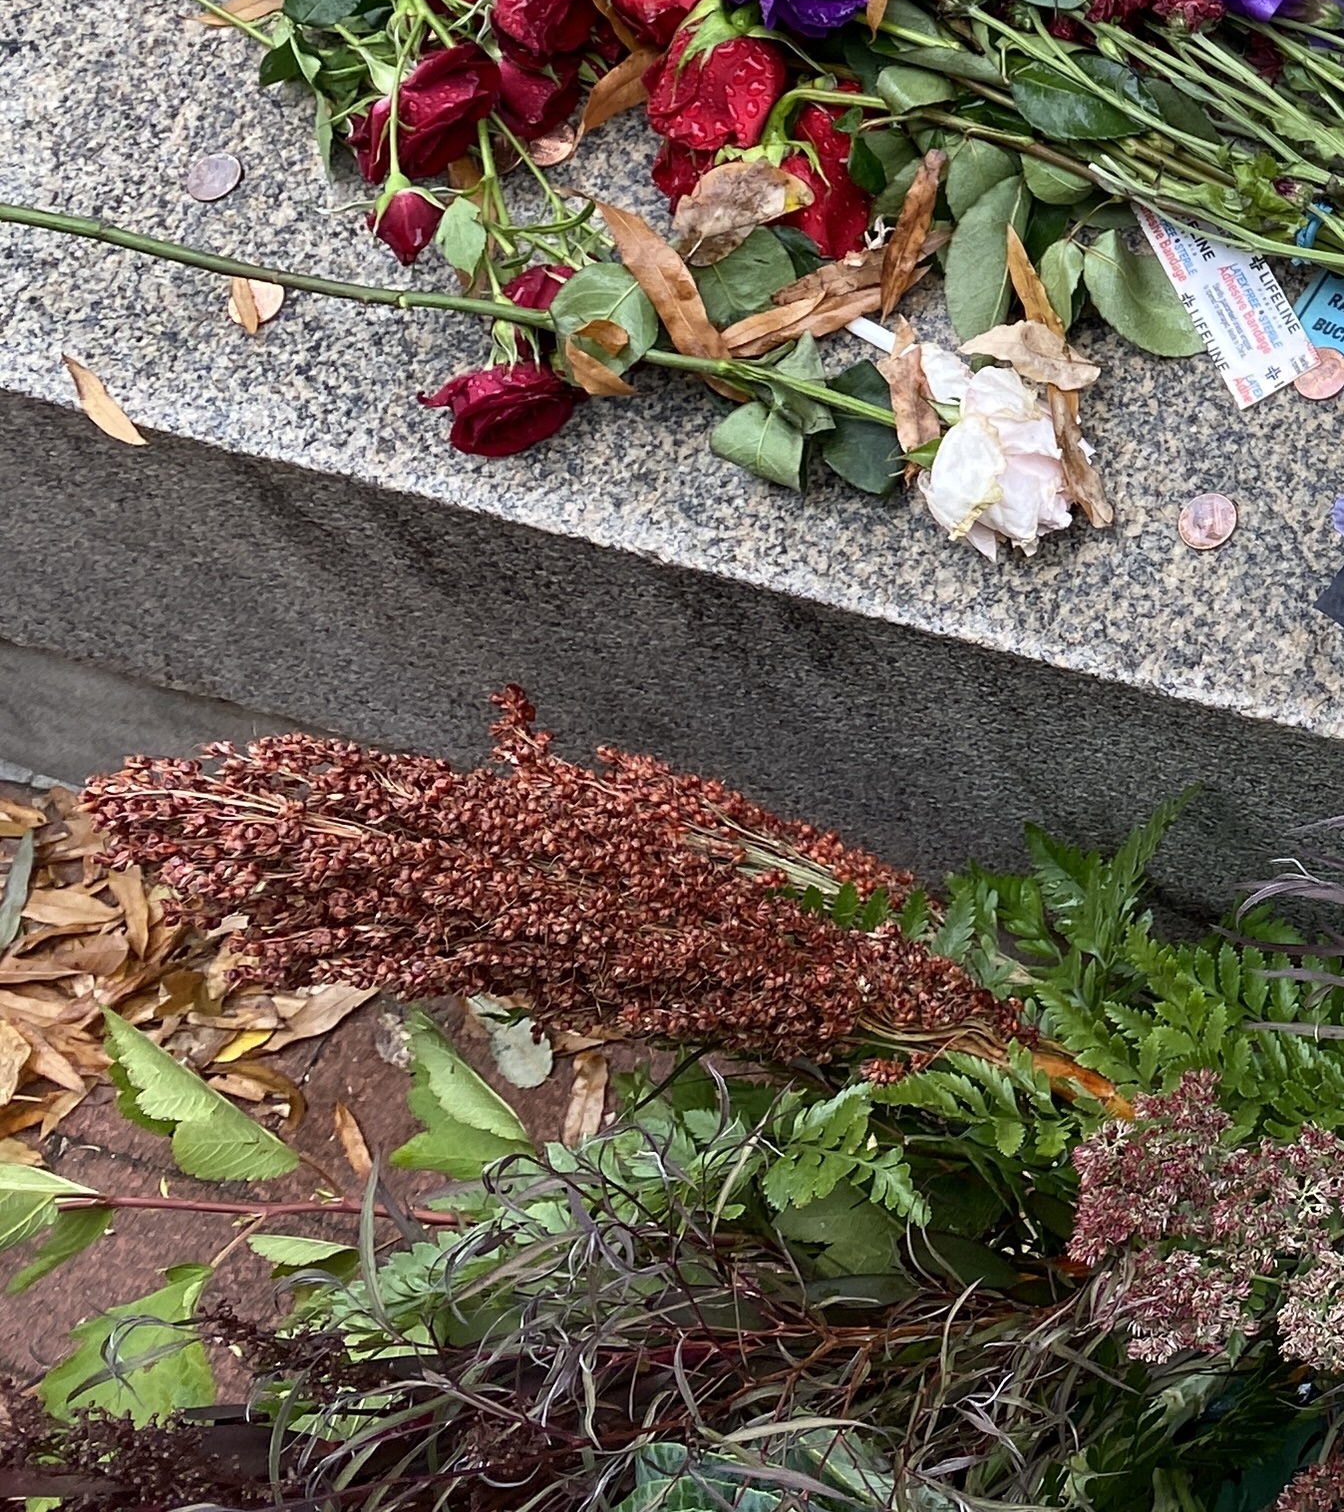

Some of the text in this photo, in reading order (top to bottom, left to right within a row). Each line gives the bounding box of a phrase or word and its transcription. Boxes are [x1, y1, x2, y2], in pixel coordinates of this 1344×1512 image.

[1159, 238, 1187, 282] Bandage
[1217, 265, 1247, 311] Adhesive
[1243, 309, 1272, 355] Bandage
[1230, 262, 1249, 289] LATEX
[1245, 288, 1262, 309] FREE
[1258, 313, 1284, 349] STERILE
[1258, 271, 1301, 335] LIFELINE
[1188, 309, 1230, 373] LIFELINE
